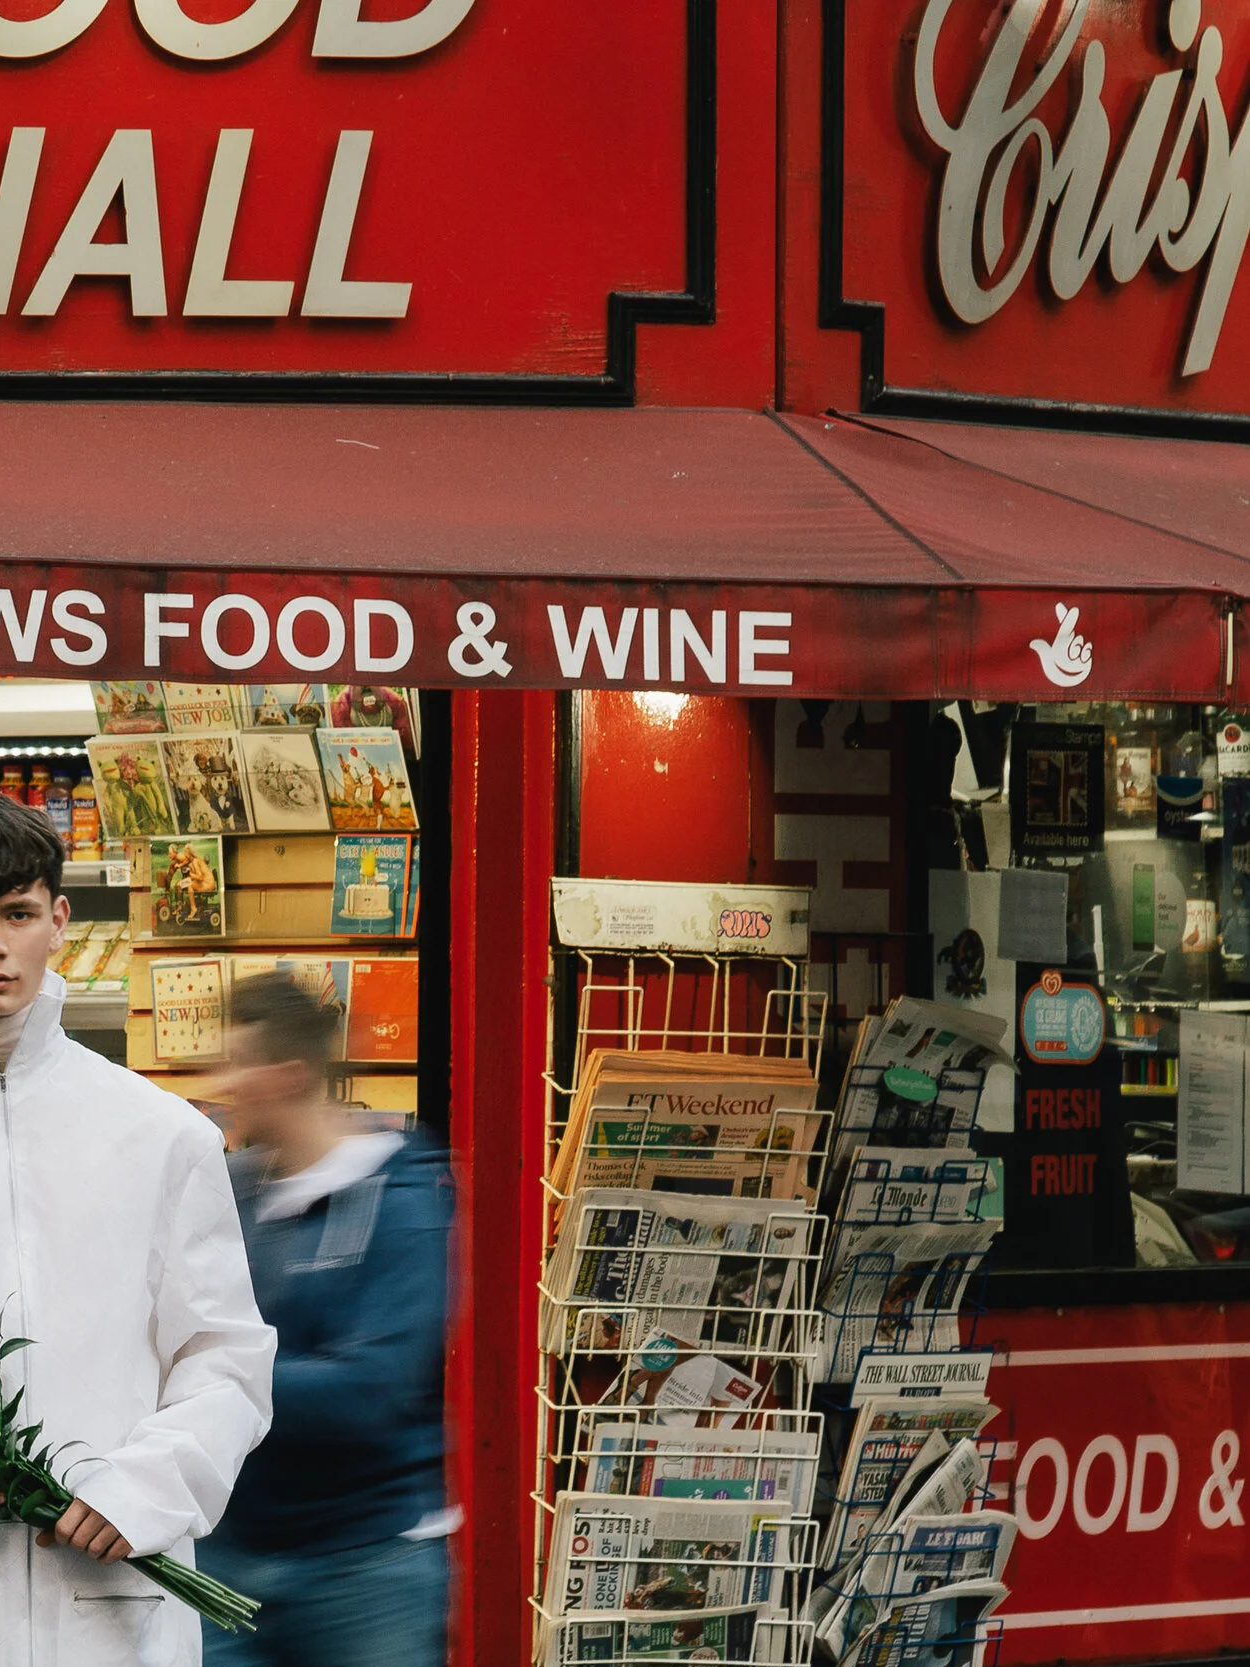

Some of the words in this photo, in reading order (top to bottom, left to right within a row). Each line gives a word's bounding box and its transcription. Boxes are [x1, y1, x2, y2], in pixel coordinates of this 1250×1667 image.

[144, 593, 414, 673] FOOD
[447, 600, 513, 678] &
[547, 604, 793, 685] WINE
[170, 709, 201, 727] NEW
[203, 707, 232, 727] JOB
[1065, 728, 1102, 746] Stamps
[1022, 832, 1064, 847] Available
[1066, 833, 1090, 848] here
[158, 1006, 191, 1025] NEW
[190, 1004, 220, 1026] JOB
[626, 1093, 663, 1113] FT
[666, 1094, 776, 1116] Weekend
[1025, 1087, 1103, 1131] FRESH
[1030, 1153, 1099, 1197] FRUIT
[884, 1185, 928, 1208] Monde
[861, 1365, 883, 1384] THE
[882, 1365, 910, 1384] WALL
[909, 1364, 945, 1383] STREET
[1198, 1429, 1246, 1530] &
